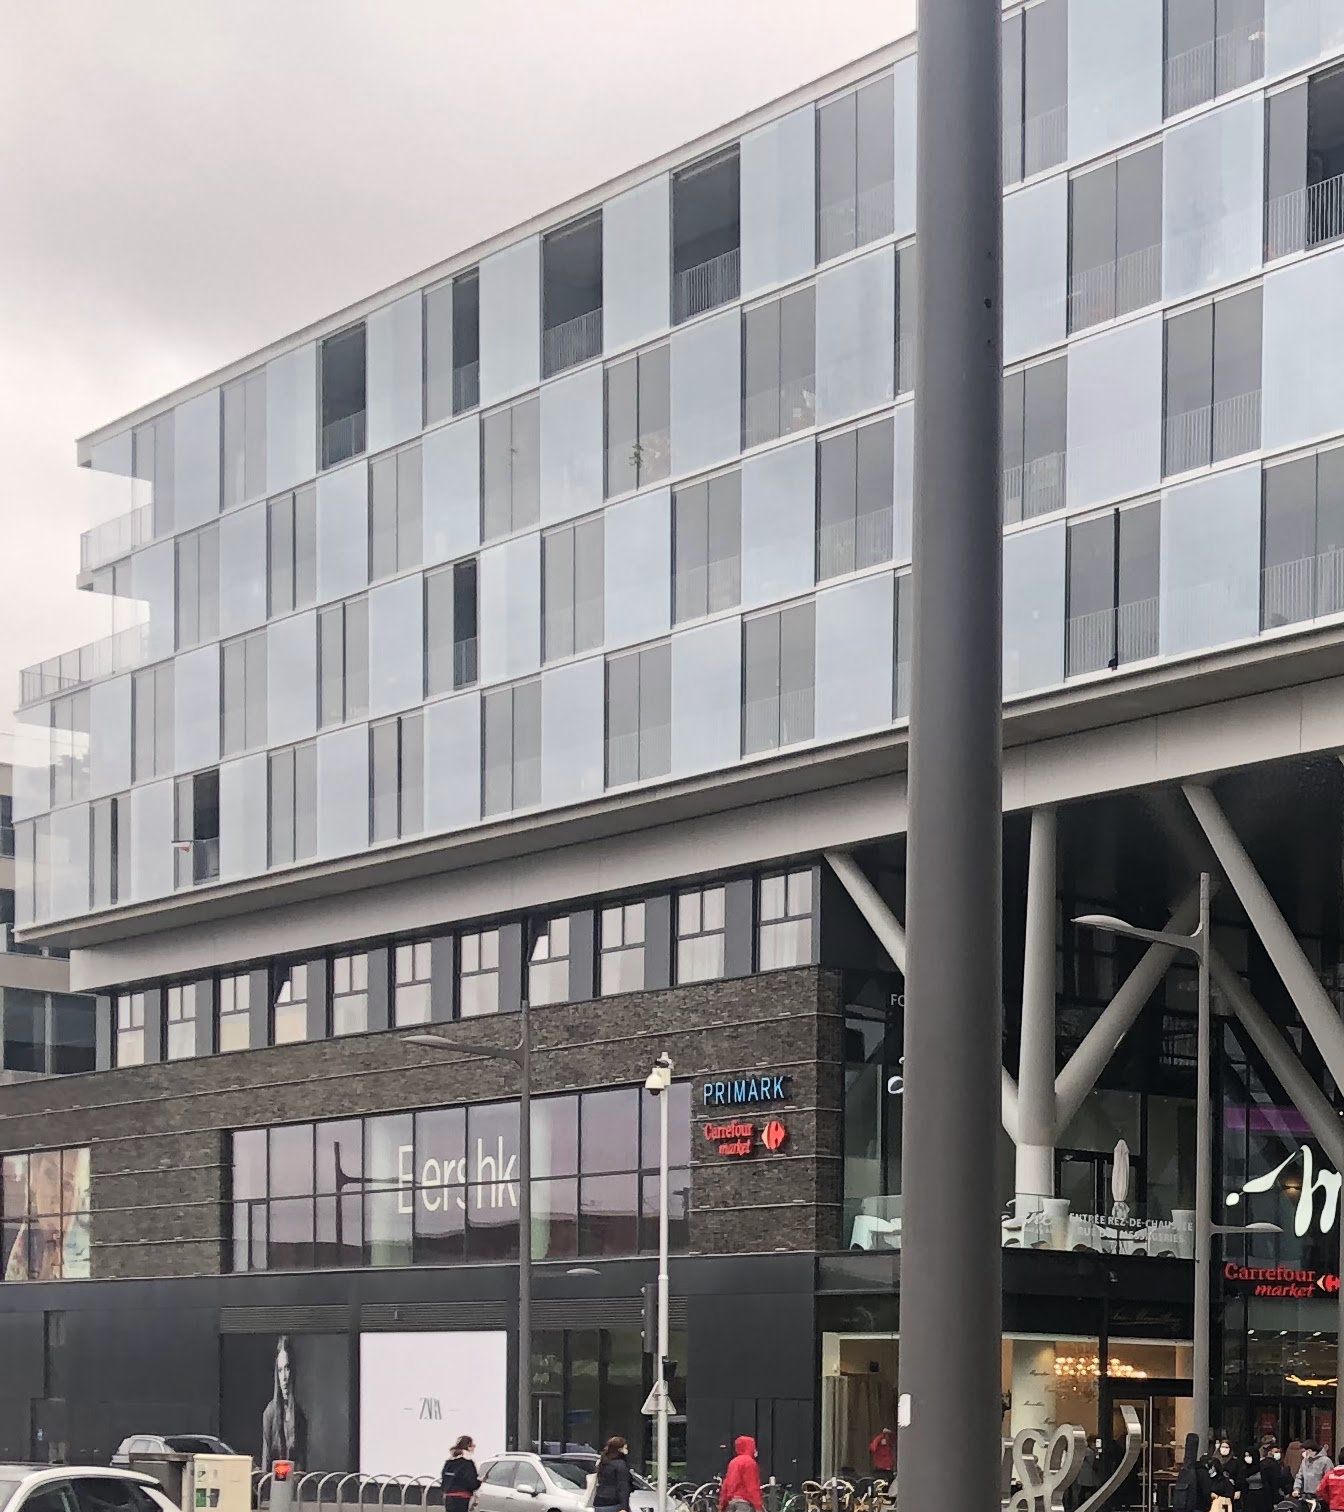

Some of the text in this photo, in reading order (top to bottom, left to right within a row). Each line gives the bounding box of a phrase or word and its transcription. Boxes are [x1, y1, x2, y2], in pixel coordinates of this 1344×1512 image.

[704, 1076, 785, 1105] PRIMARK
[704, 1120, 754, 1140] Carrefour
[719, 1140, 751, 1155] market
[1225, 1263, 1316, 1282] Carrefour
[1255, 1283, 1316, 1298] market
